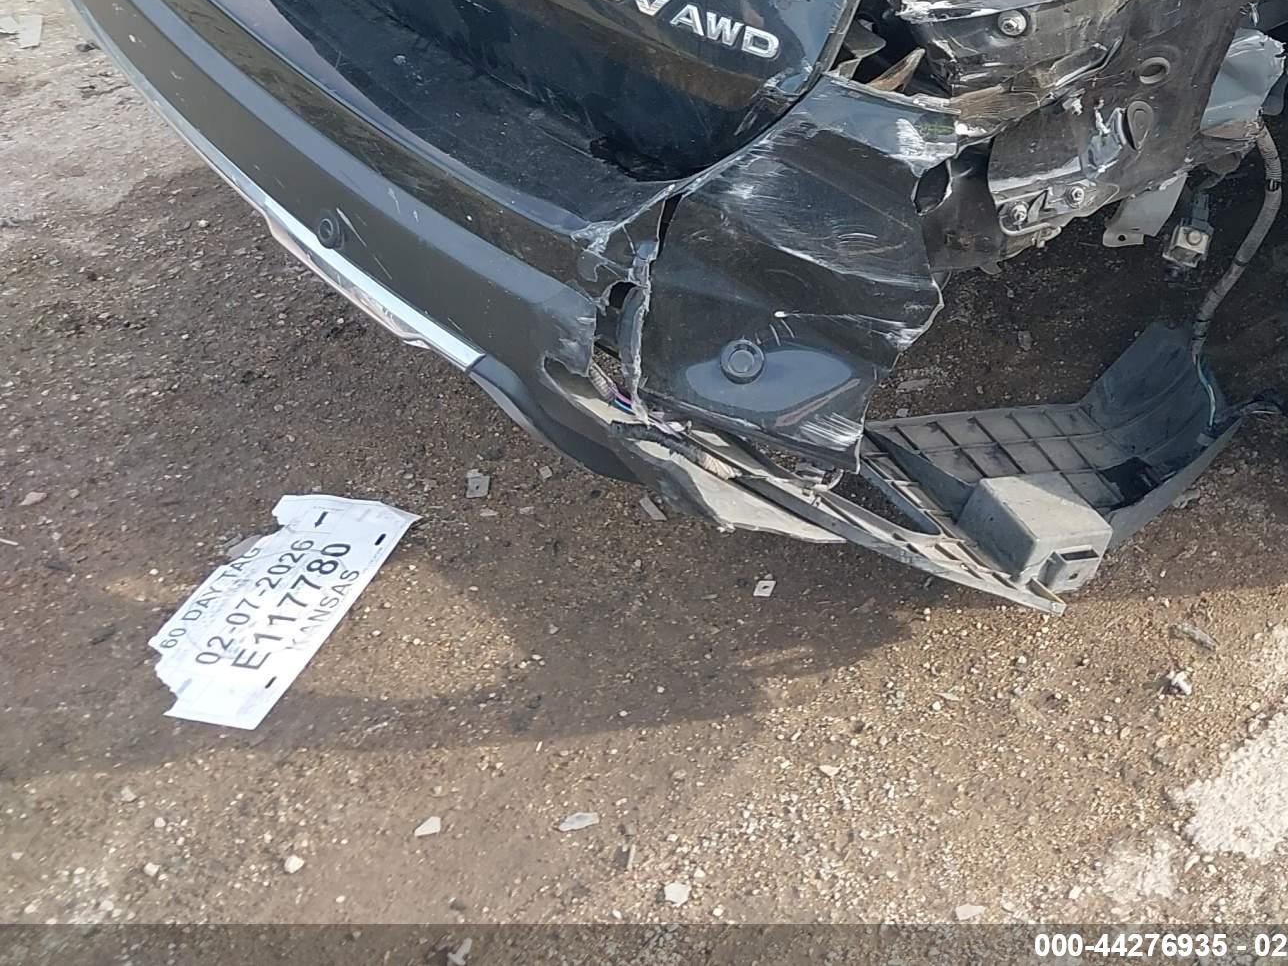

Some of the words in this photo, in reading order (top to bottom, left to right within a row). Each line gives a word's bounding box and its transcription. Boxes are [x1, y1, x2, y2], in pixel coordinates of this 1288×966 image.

[669, 3, 780, 59] AWD
[160, 628, 187, 649] 60
[181, 586, 223, 622] DAY
[215, 547, 262, 582] TAG
[195, 539, 314, 665] 02-07-2026
[231, 543, 351, 670] E117780
[284, 569, 360, 651] KANSAS
